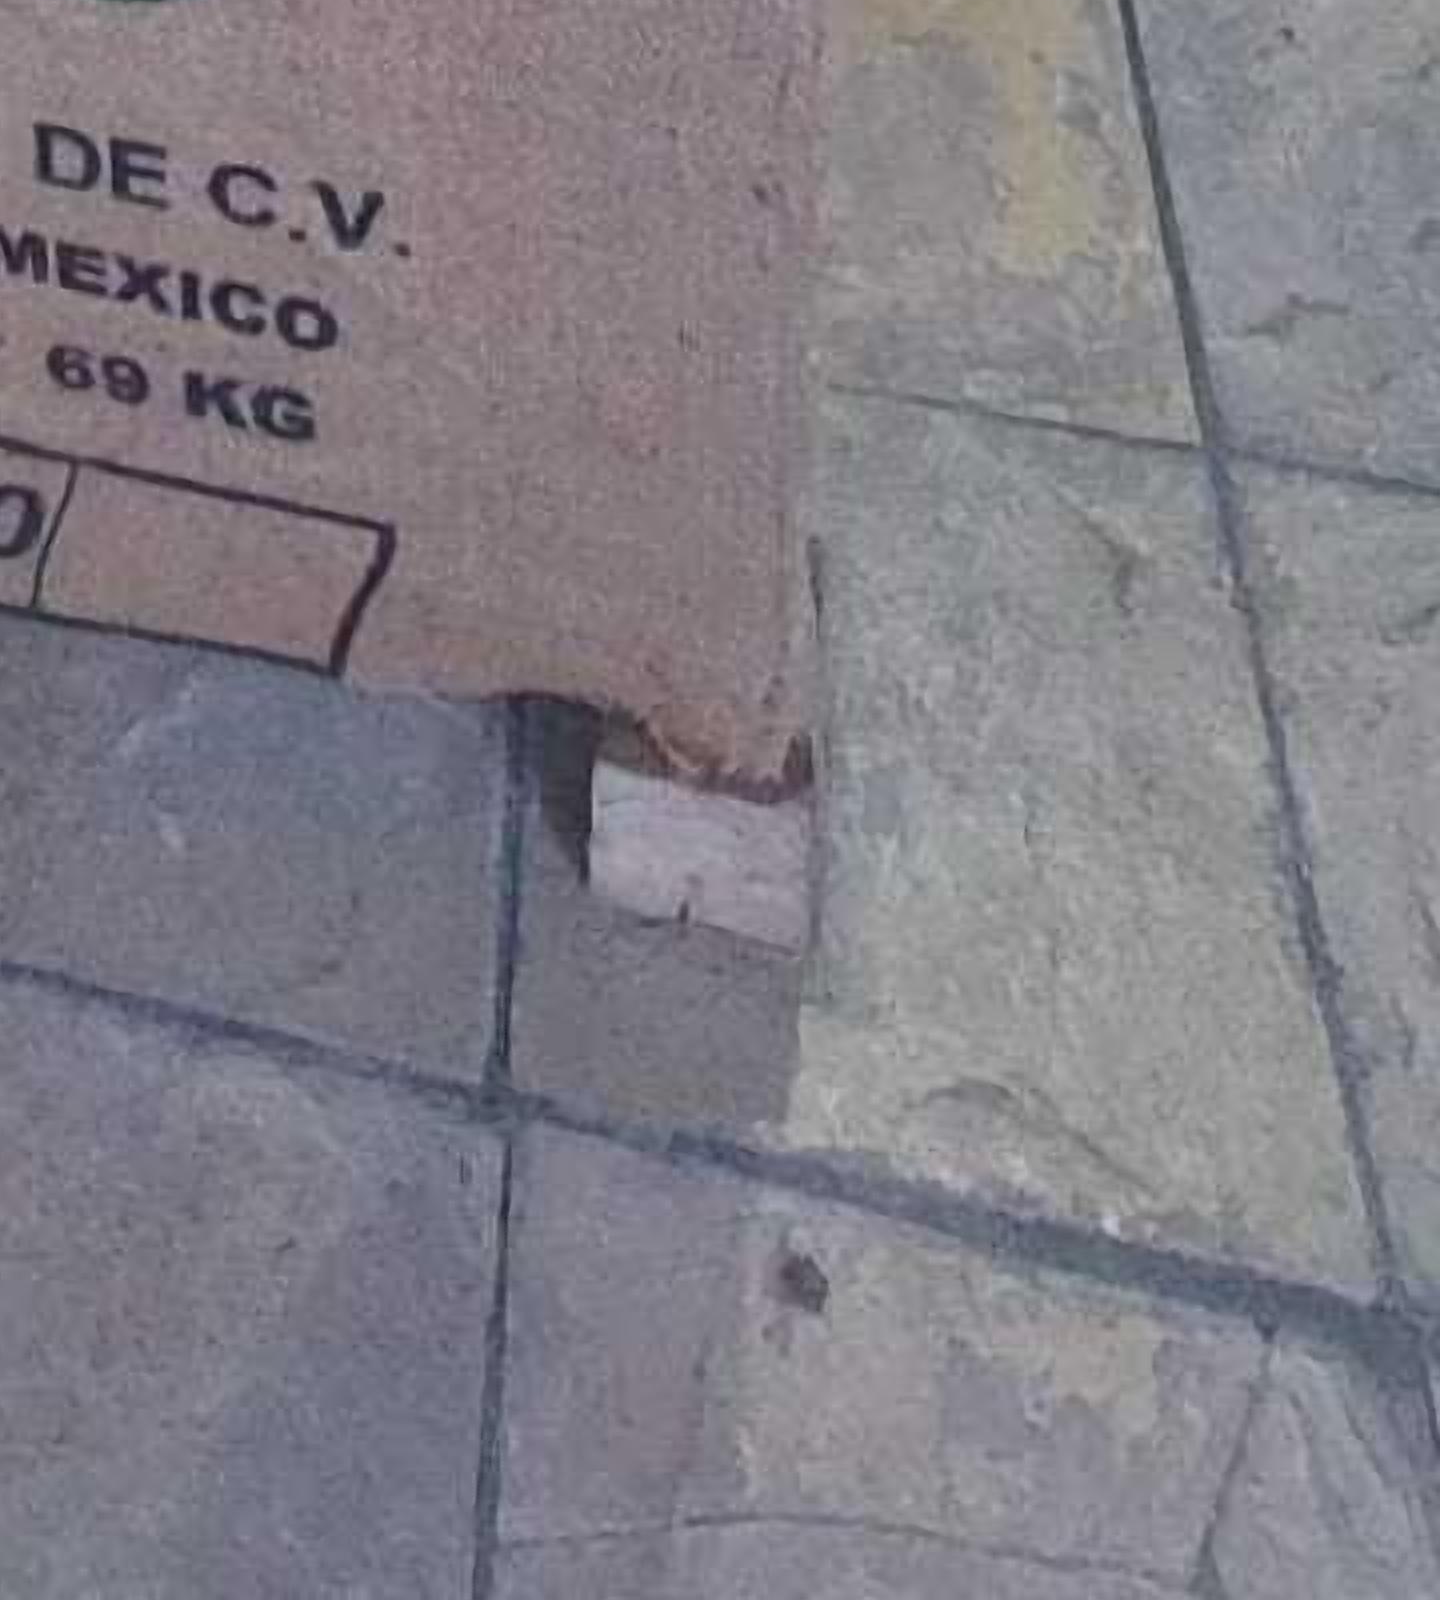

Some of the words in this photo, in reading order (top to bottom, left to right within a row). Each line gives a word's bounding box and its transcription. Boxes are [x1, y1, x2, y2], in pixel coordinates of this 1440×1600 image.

[33, 122, 171, 210] DE
[206, 162, 410, 257] C.V.
[45, 343, 150, 406] 69
[181, 369, 317, 441] KG
